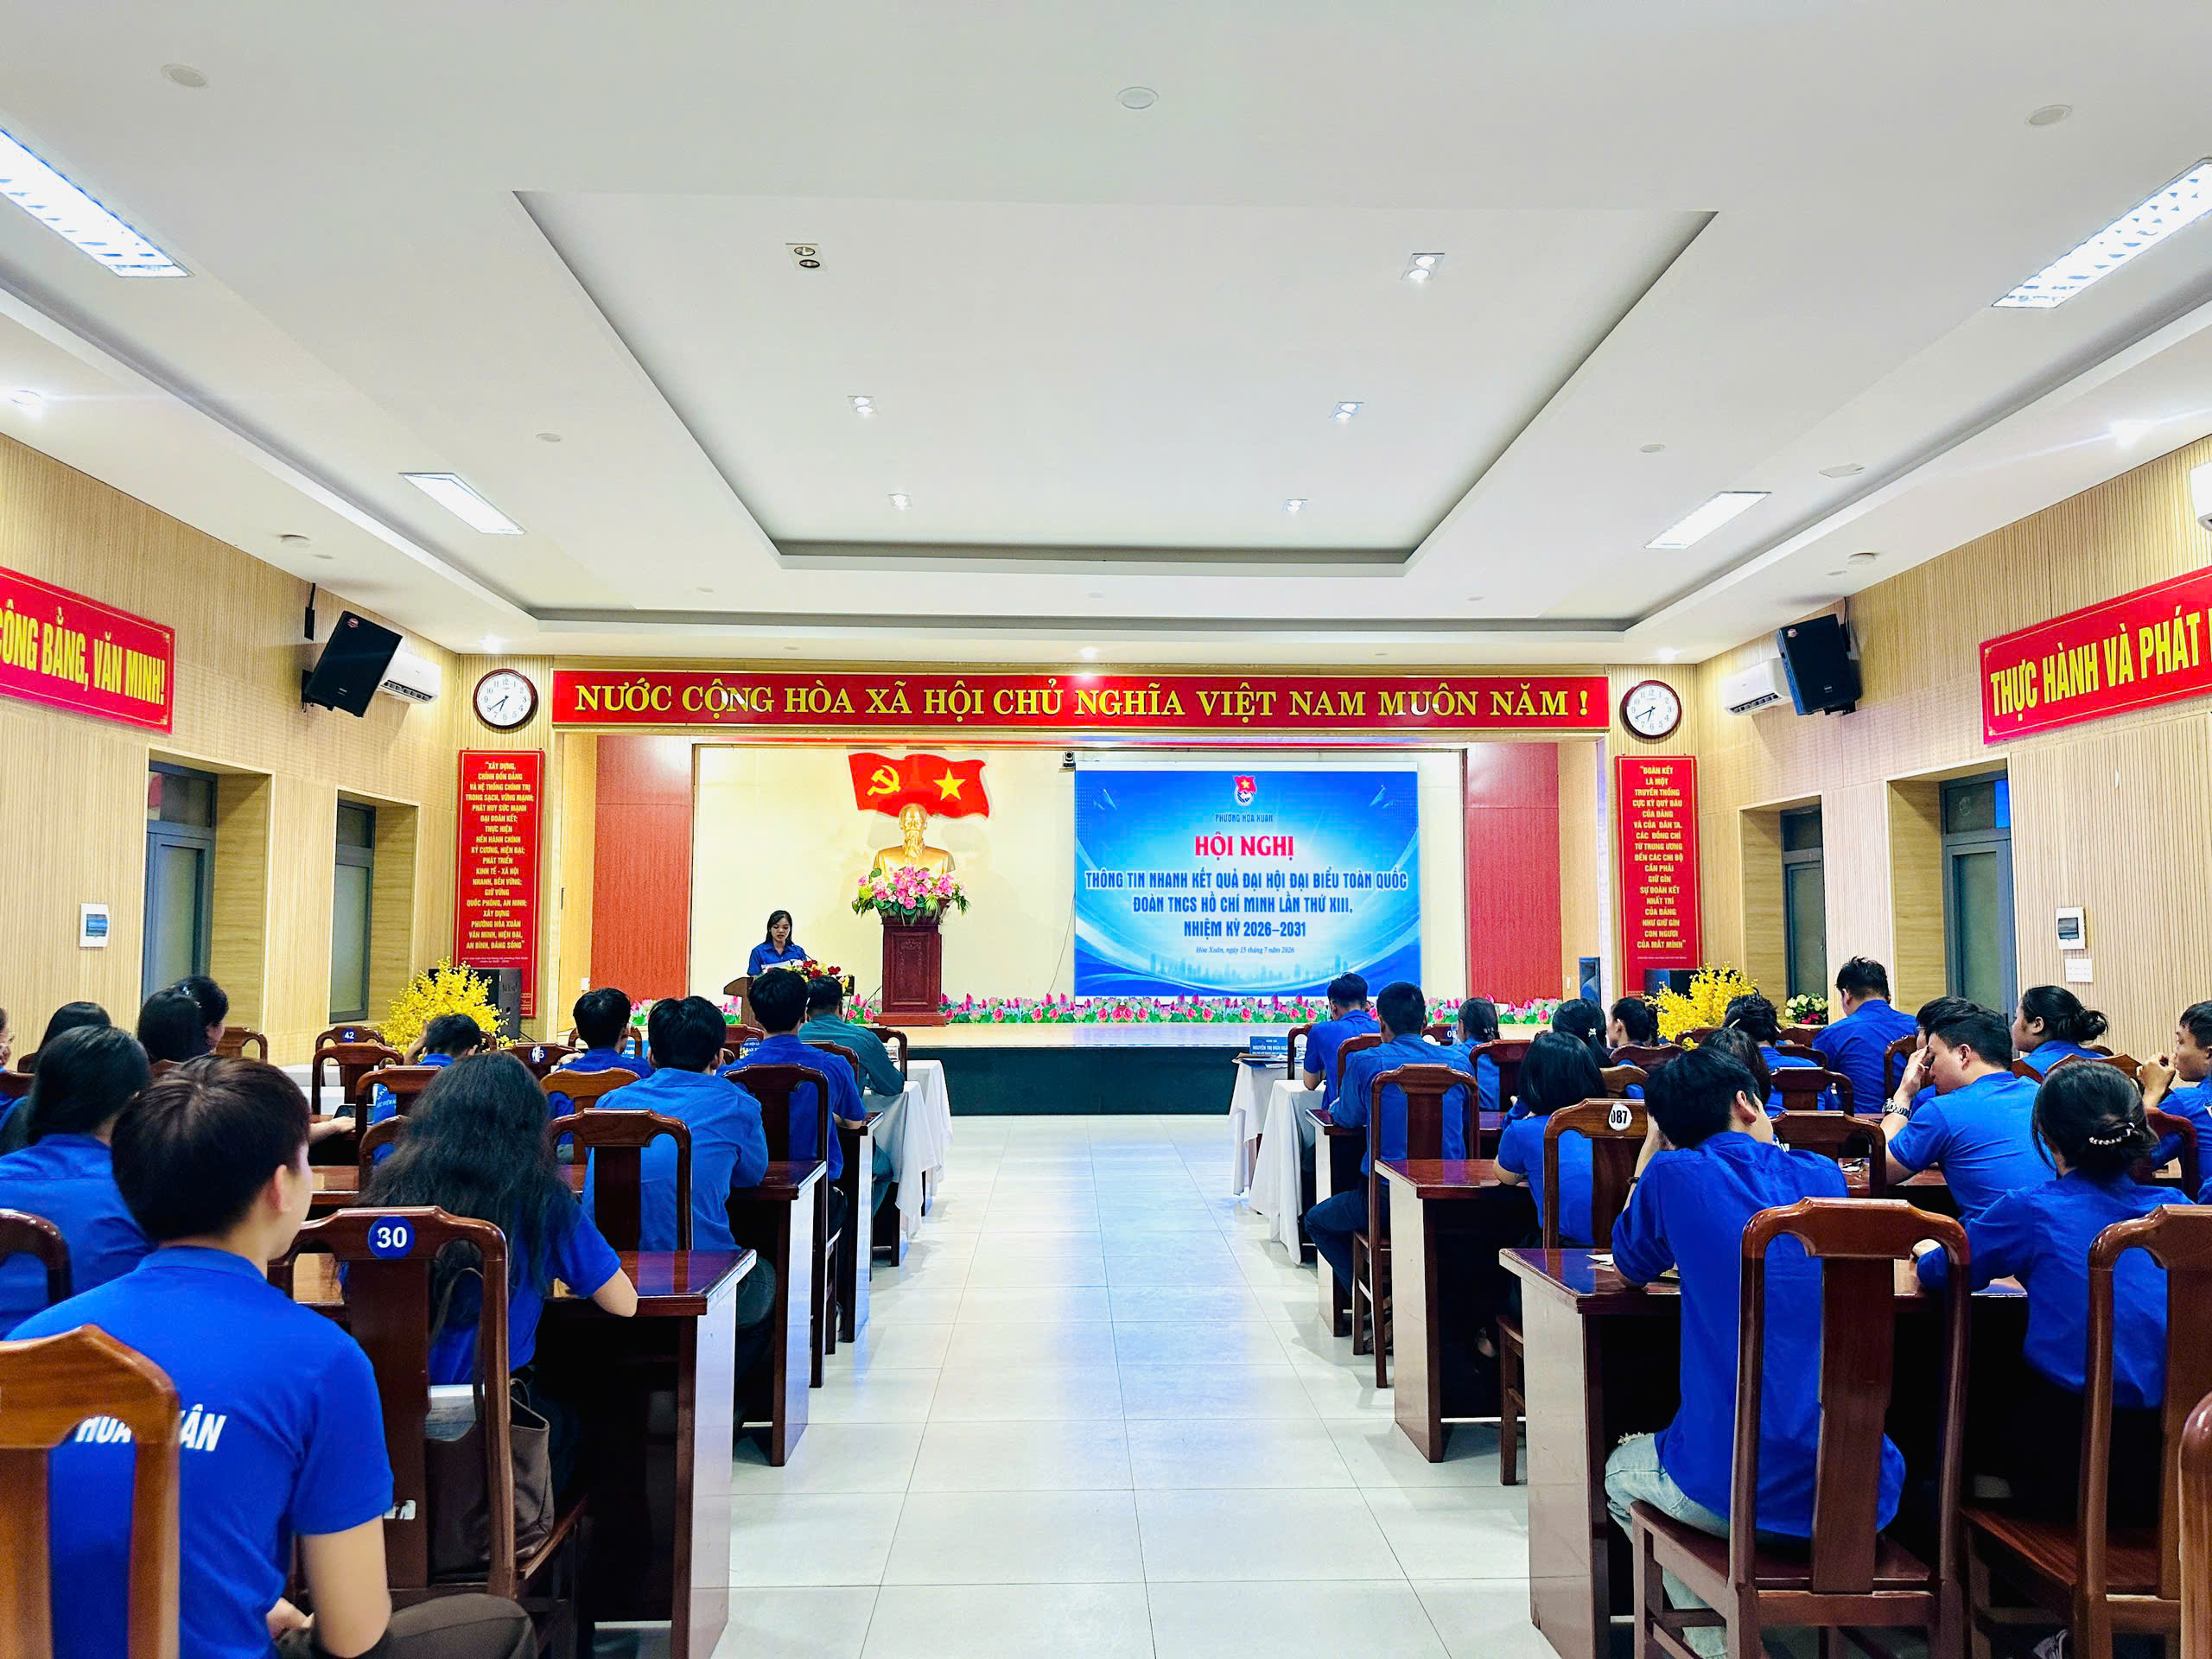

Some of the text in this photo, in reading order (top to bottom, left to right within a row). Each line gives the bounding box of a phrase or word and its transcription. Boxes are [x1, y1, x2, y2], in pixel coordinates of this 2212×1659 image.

[0, 599, 166, 706] ÔNG BẰNG, VĂN MINH!
[1990, 658, 2037, 721] THỰC
[2043, 642, 2099, 704] HÀNH
[2103, 623, 2134, 688] VÀ
[2139, 605, 2200, 679] PHÁT
[575, 677, 672, 712] NƯỚC
[682, 678, 774, 720] CỘNG
[784, 679, 855, 714] HÒA
[865, 681, 913, 715] XÃ
[924, 680, 984, 722] HỘI
[994, 678, 1064, 715] CHỦ
[1075, 683, 1185, 715] NGHĨA
[1196, 682, 1276, 723] VIỆT
[1288, 691, 1366, 716] NAM
[1378, 682, 1478, 717] MUÔN
[1490, 683, 1568, 716] NĂM
[1195, 831, 1294, 861] HỘI NGHỊ
[1086, 867, 1407, 891] THÔNG TIN NHANH KẾT QUẢ ĐẠI HỘI ĐẠI BIỂU TOÀN QUỐC
[1134, 893, 1164, 912] ĐOÀN
[1168, 897, 1197, 912] TNCS
[1201, 891, 1216, 912] HỒ
[1221, 893, 1239, 912] CHÍ
[1244, 897, 1274, 912] MINH
[1279, 892, 1300, 912] LẦN
[1304, 894, 1325, 912] THỨ
[1184, 918, 1222, 939] NHIỆM
[1226, 918, 1240, 937] KỲ
[1611, 1110, 1627, 1123] 087
[377, 1227, 407, 1248] 30
